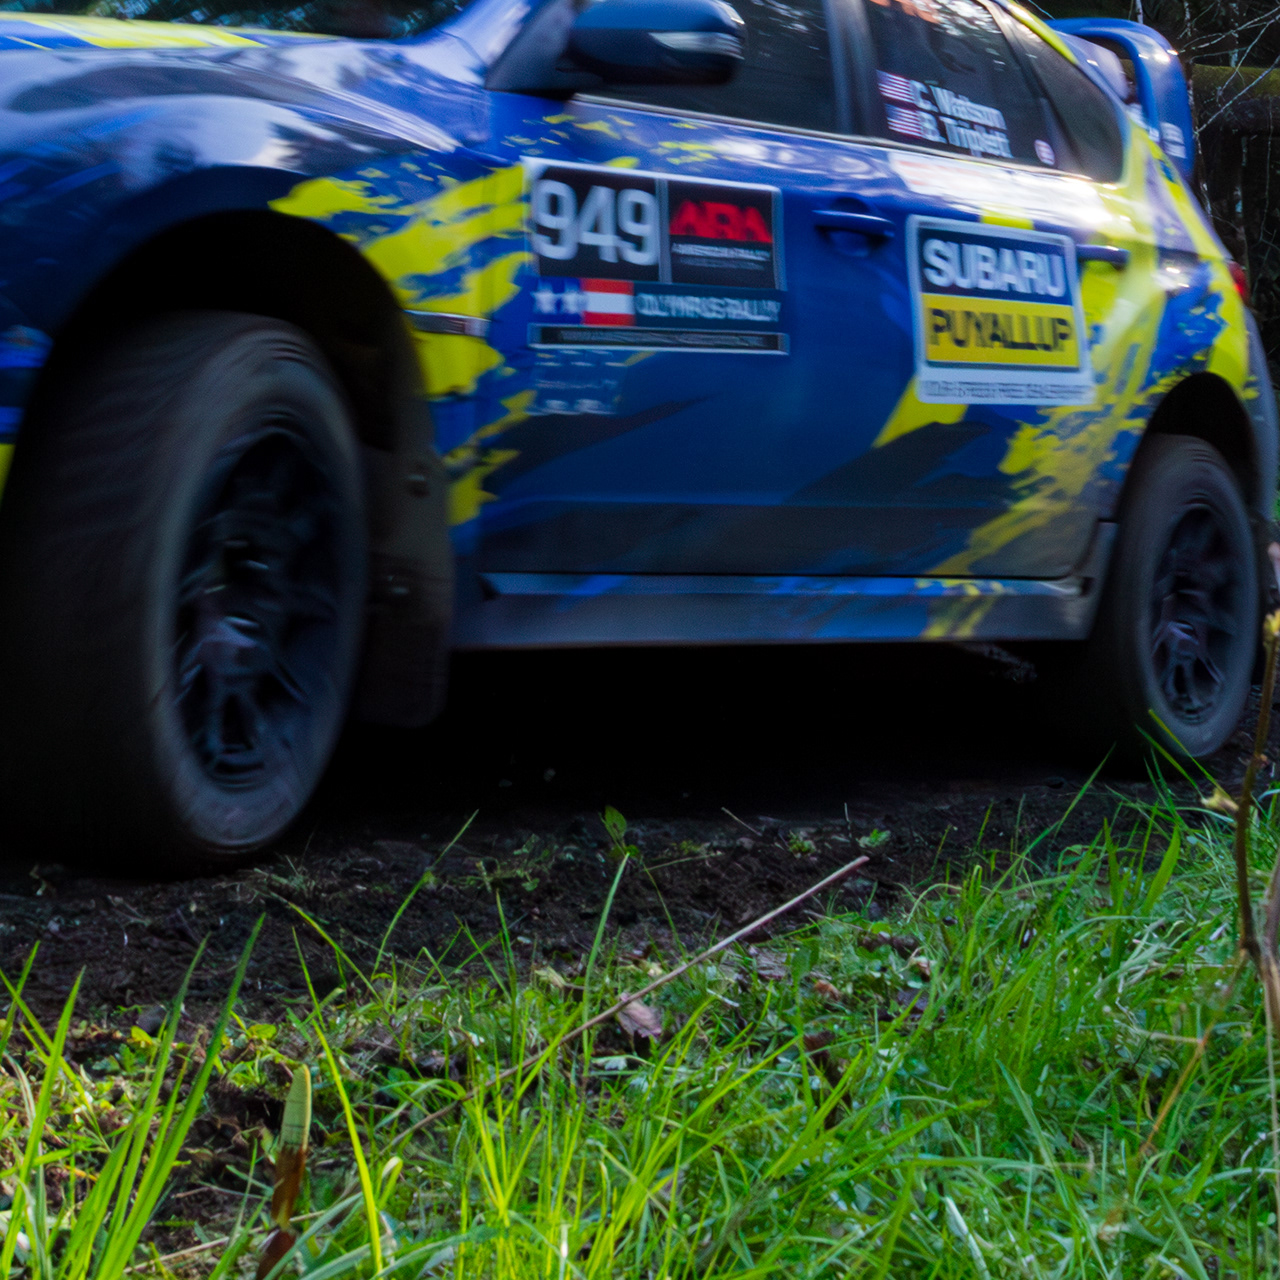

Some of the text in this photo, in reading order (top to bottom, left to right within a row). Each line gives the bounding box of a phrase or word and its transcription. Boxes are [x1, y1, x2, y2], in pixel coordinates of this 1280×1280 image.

[532, 178, 659, 266] 949
[670, 199, 773, 244] ARA
[922, 238, 1067, 298] SUBARU
[928, 307, 1071, 353] PUYALLUP
